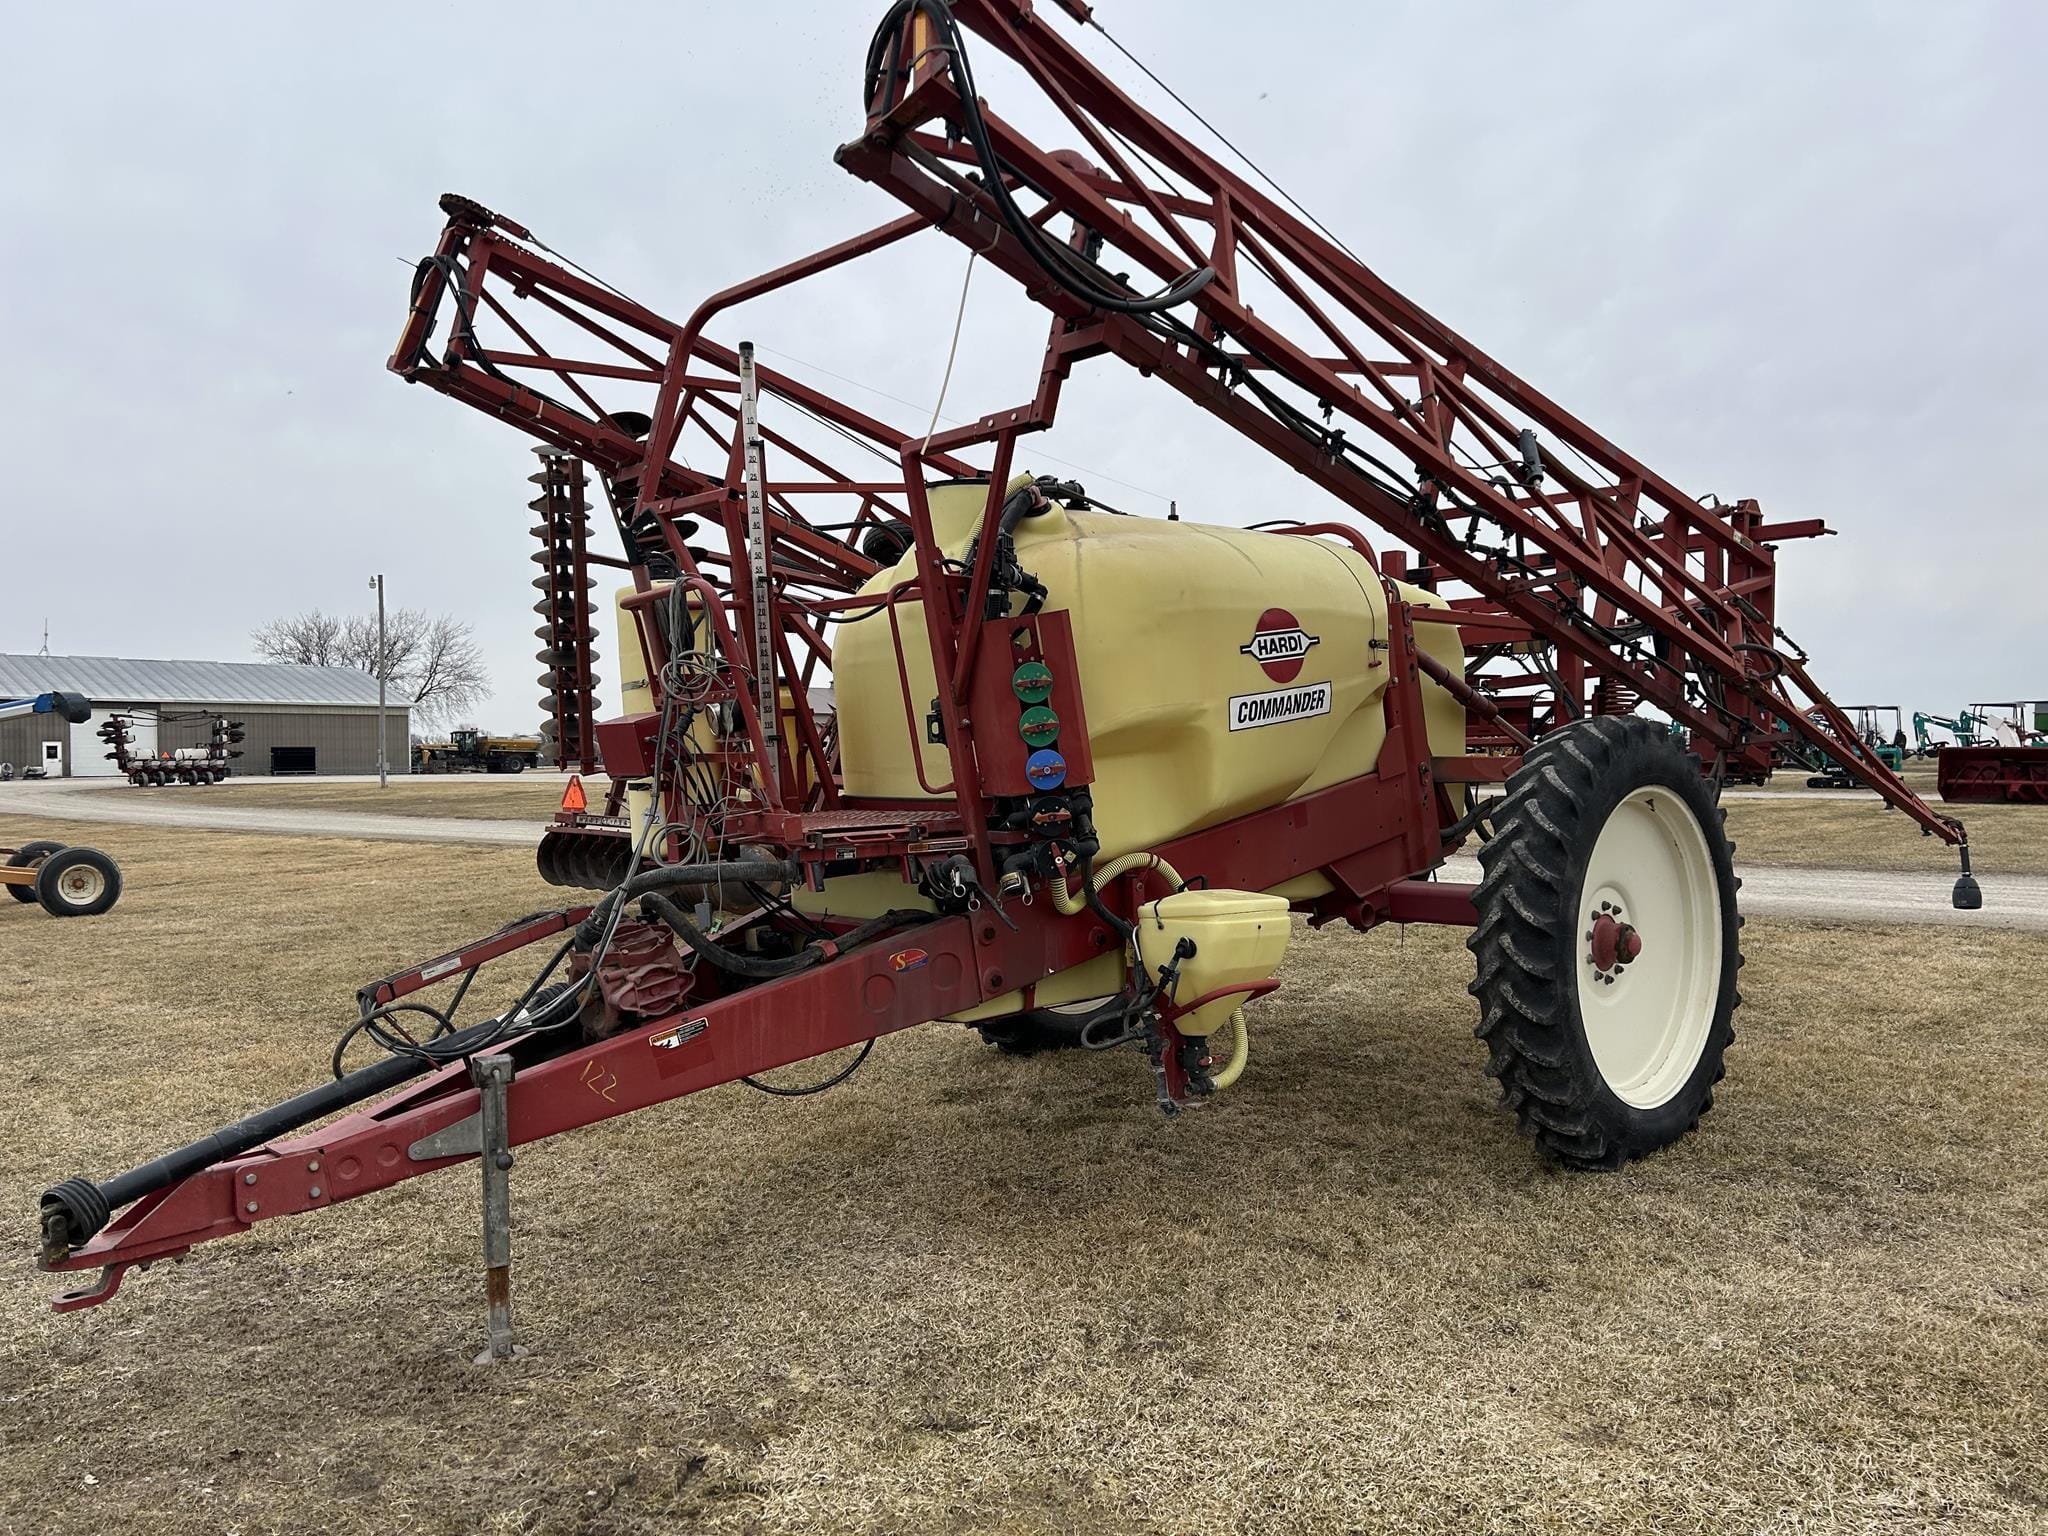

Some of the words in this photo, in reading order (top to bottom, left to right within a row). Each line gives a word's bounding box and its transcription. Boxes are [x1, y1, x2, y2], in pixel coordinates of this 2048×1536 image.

[749, 455, 757, 463] 20
[750, 473, 758, 481] 25
[751, 490, 759, 498] 30
[752, 506, 760, 514] 35
[753, 521, 761, 529] 40
[755, 551, 763, 559] 50
[758, 608, 766, 616] 70
[1257, 634, 1303, 656] HARDI
[1237, 689, 1326, 724] COMMANDER
[764, 721, 774, 729] 110
[579, 1060, 618, 1103] 122
